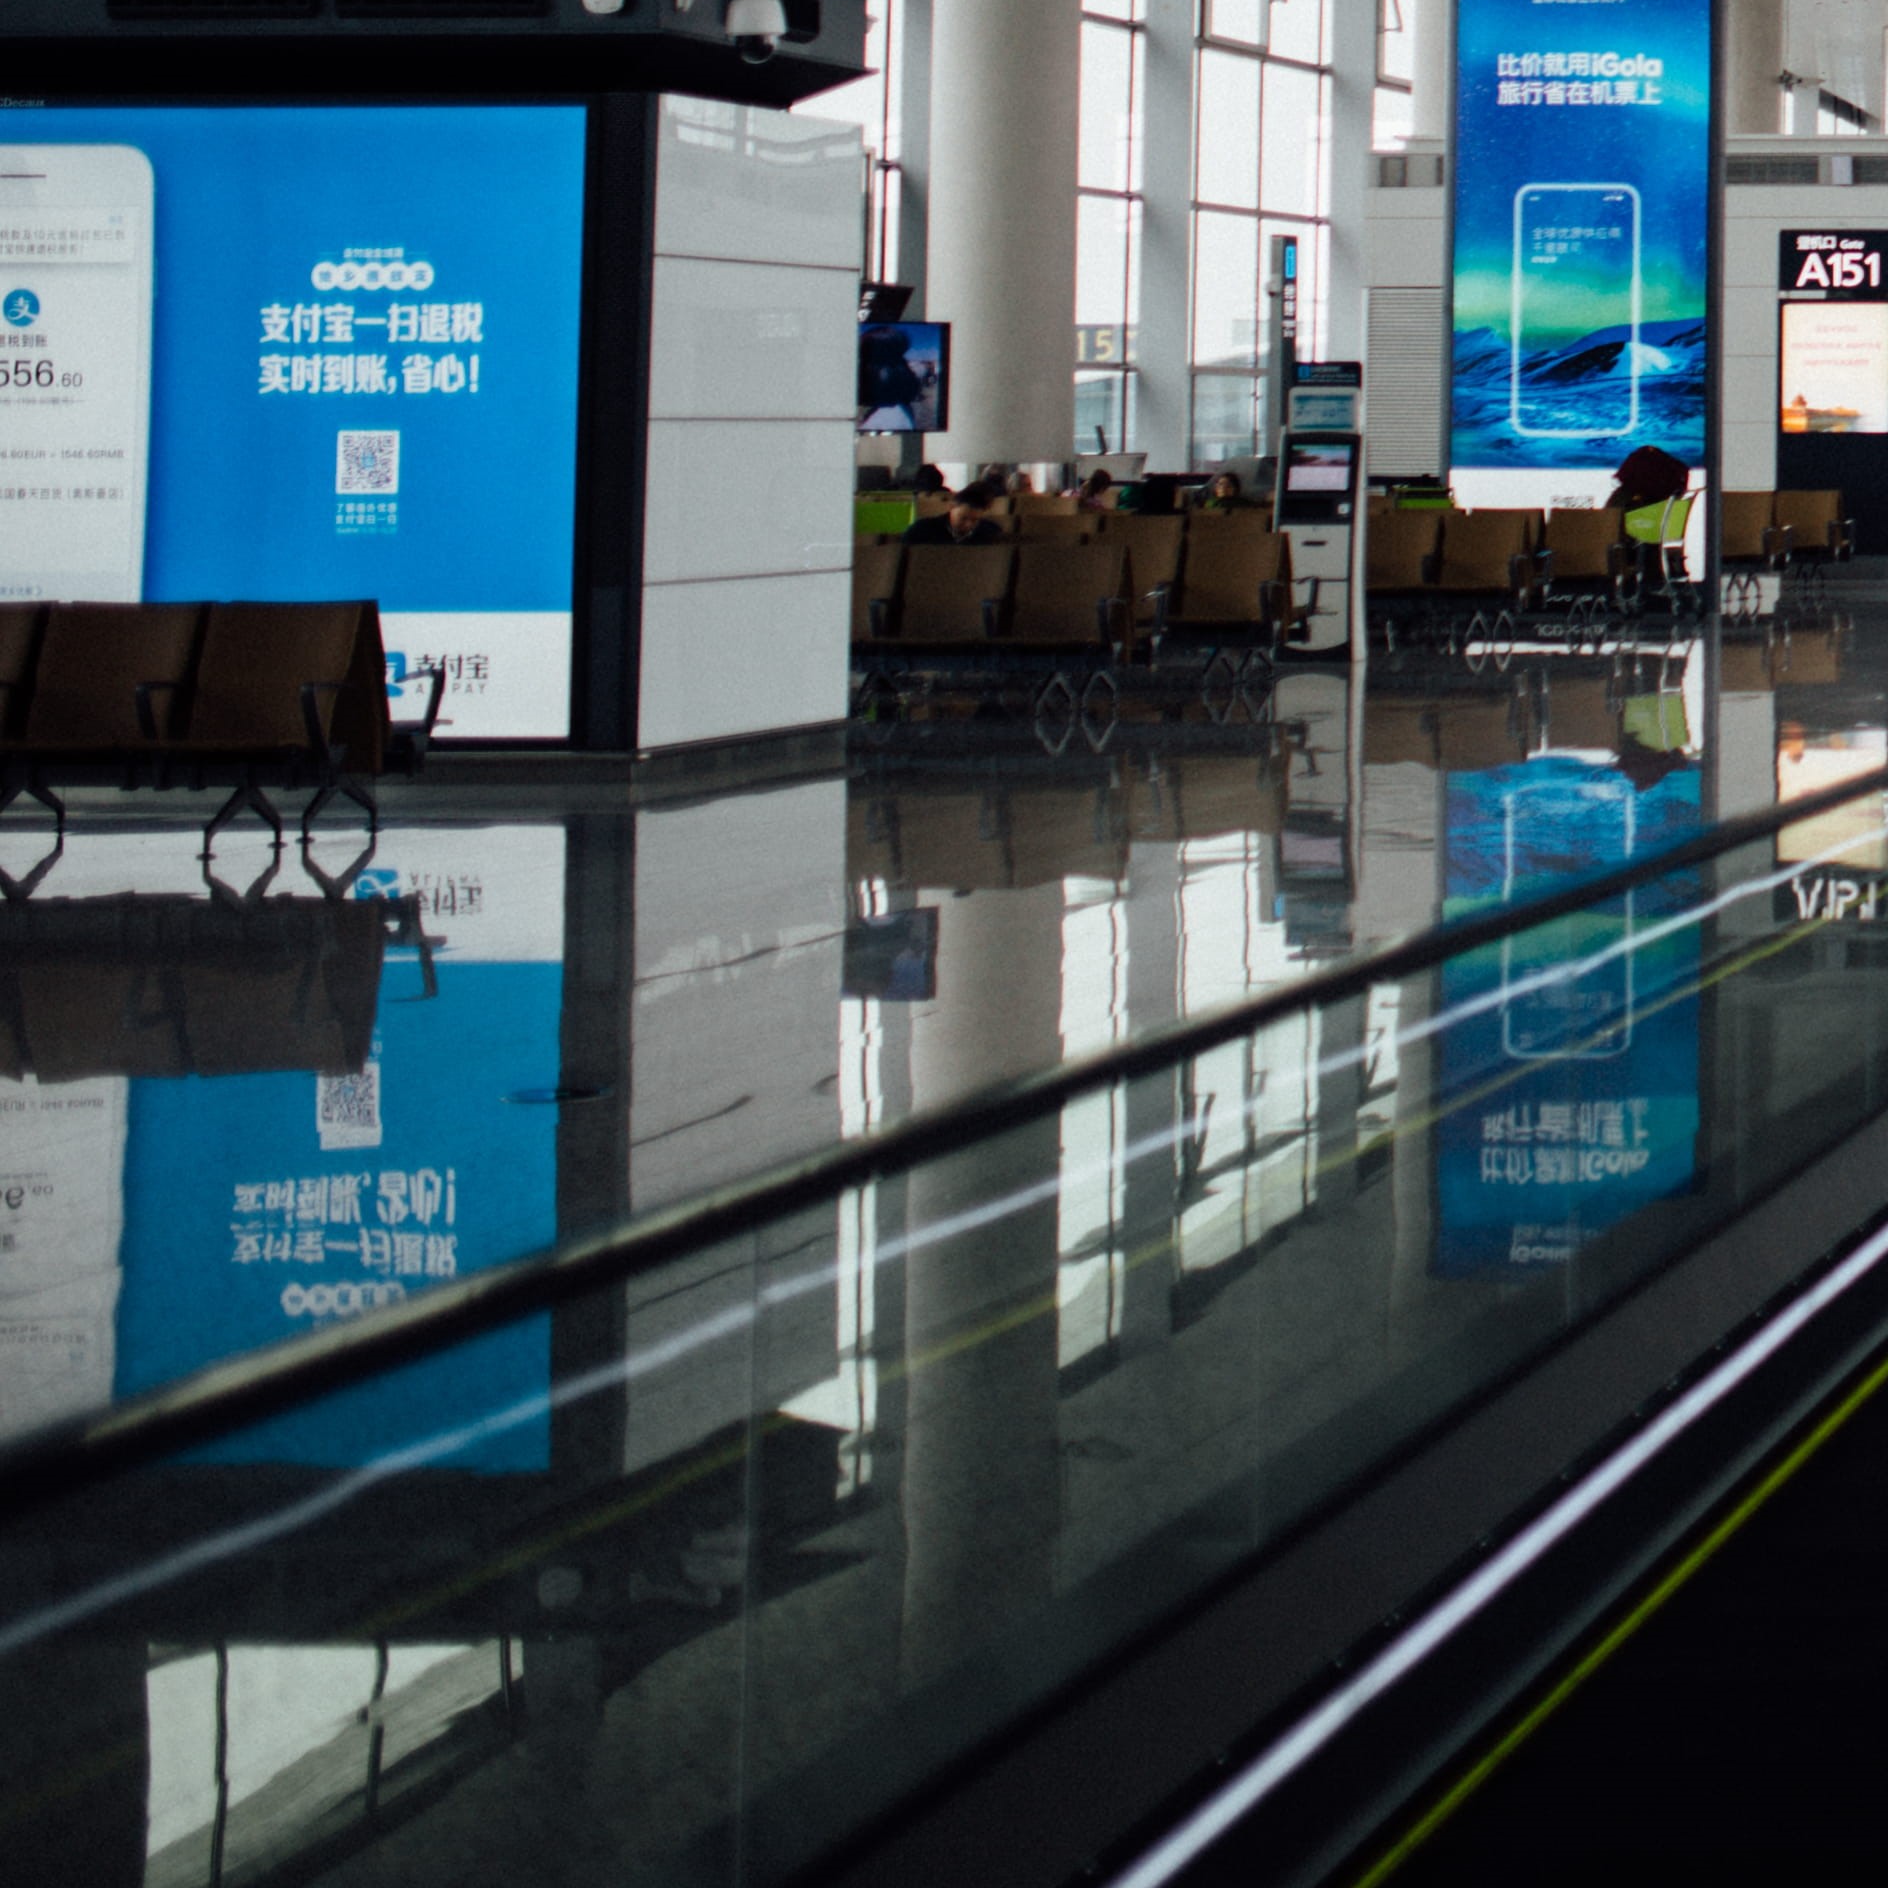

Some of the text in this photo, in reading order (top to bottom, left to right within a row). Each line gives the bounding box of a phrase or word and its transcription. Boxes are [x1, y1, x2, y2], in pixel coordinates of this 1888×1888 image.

[1497, 52, 1664, 77] 比价就用iGola
[1497, 80, 1662, 105] 旅行省在机票上
[1795, 252, 1881, 287] A151
[259, 303, 483, 343] 支付宝一扫退税
[415, 683, 487, 694] APAY
